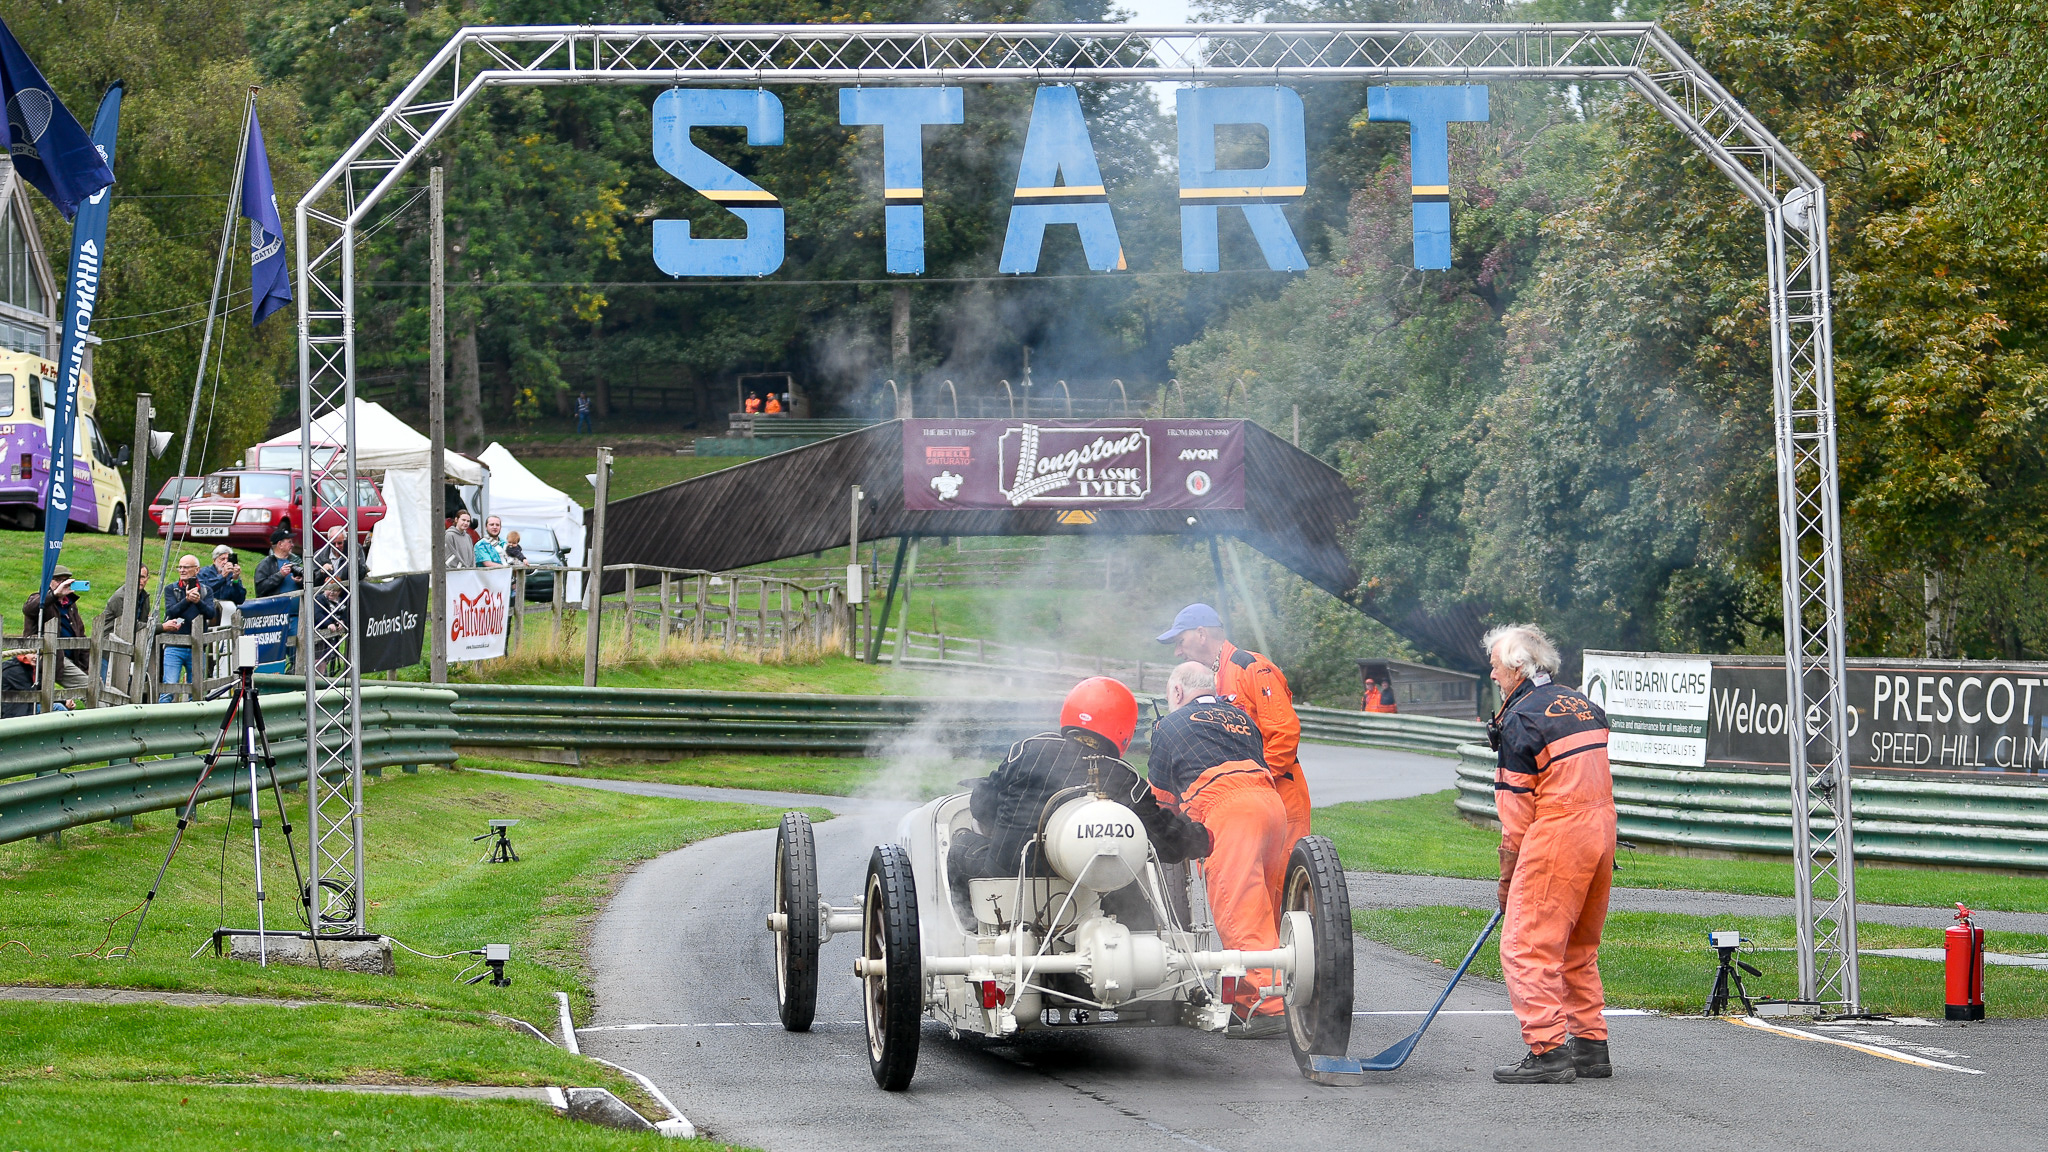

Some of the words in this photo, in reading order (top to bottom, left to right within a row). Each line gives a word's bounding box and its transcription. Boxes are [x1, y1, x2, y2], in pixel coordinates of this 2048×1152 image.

[652, 86, 1489, 276] START
[926, 457, 970, 466] CINTURATO
[1178, 448, 1219, 460] AVON
[1008, 423, 1142, 507] Longstone
[1076, 467, 1142, 480] CLASSIC
[1077, 481, 1142, 496] TYRES
[1610, 669, 1632, 691] NEW
[1635, 671, 1668, 693] BARN
[1671, 672, 1706, 695] CARS
[1637, 698, 1661, 710] SERVICE
[1663, 700, 1688, 711] CENTRE
[1873, 675, 2048, 725] PRESCOT
[1574, 710, 1595, 722] VSCC
[1221, 722, 1252, 736] VSCC
[1626, 720, 1634, 729] and
[1630, 741, 1652, 754] ROVER
[1653, 743, 1697, 757] SPECIALISTS
[1870, 732, 1932, 765] SPEED
[1940, 735, 1986, 767] HILL
[1077, 823, 1135, 839] LN2420
